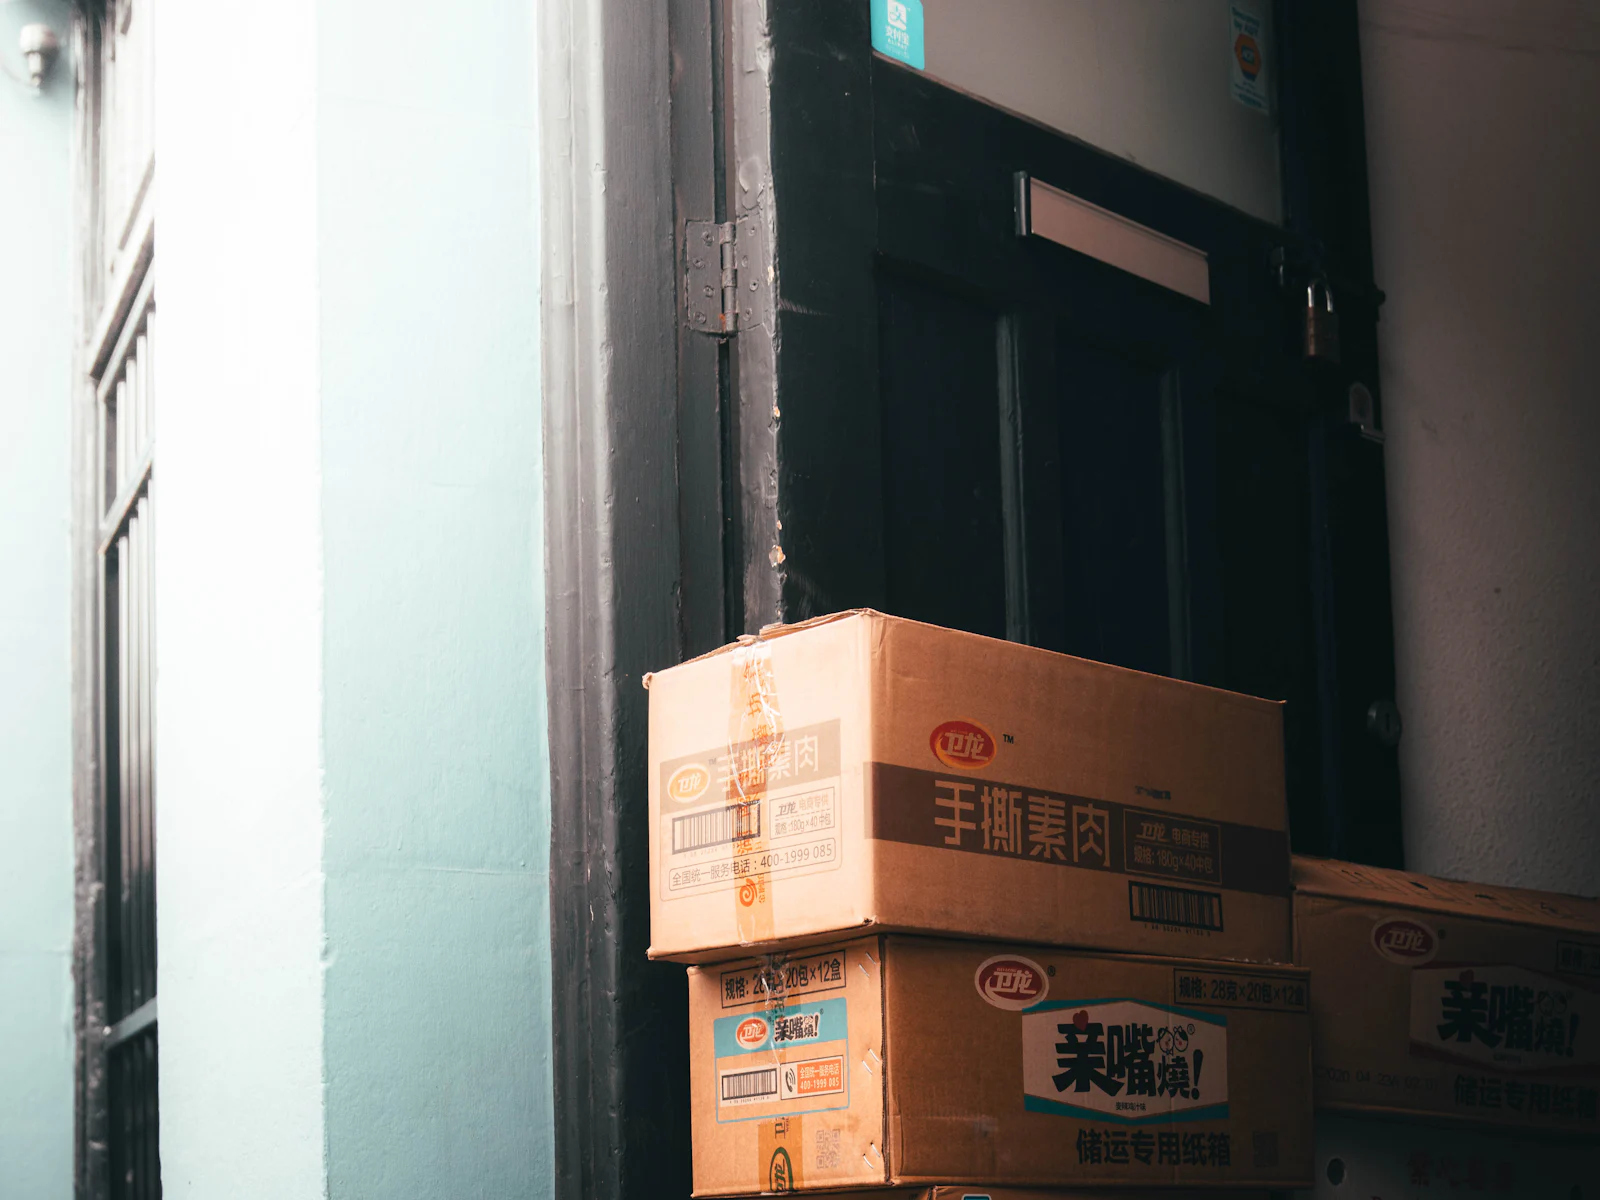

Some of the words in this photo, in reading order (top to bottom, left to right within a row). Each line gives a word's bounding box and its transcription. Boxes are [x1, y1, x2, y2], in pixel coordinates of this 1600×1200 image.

[944, 731, 989, 761] 卫龙
[1003, 734, 1014, 744] TM
[716, 734, 819, 794] 手撕素肉
[934, 779, 1110, 868] 手撕素肉
[1136, 821, 1170, 842] 卫龙
[813, 843, 832, 860] 085
[1387, 928, 1426, 952] 卫龙
[992, 969, 1037, 995] 卫龙
[741, 1023, 766, 1042] 卫龙
[800, 1063, 840, 1080] 全国统一服务电话
[800, 1078, 827, 1090] 400-1999
[829, 1076, 840, 1087] 085
[1454, 1073, 1599, 1120] 储运专用纸箱
[1076, 1128, 1232, 1167] 储运专用纸箱
